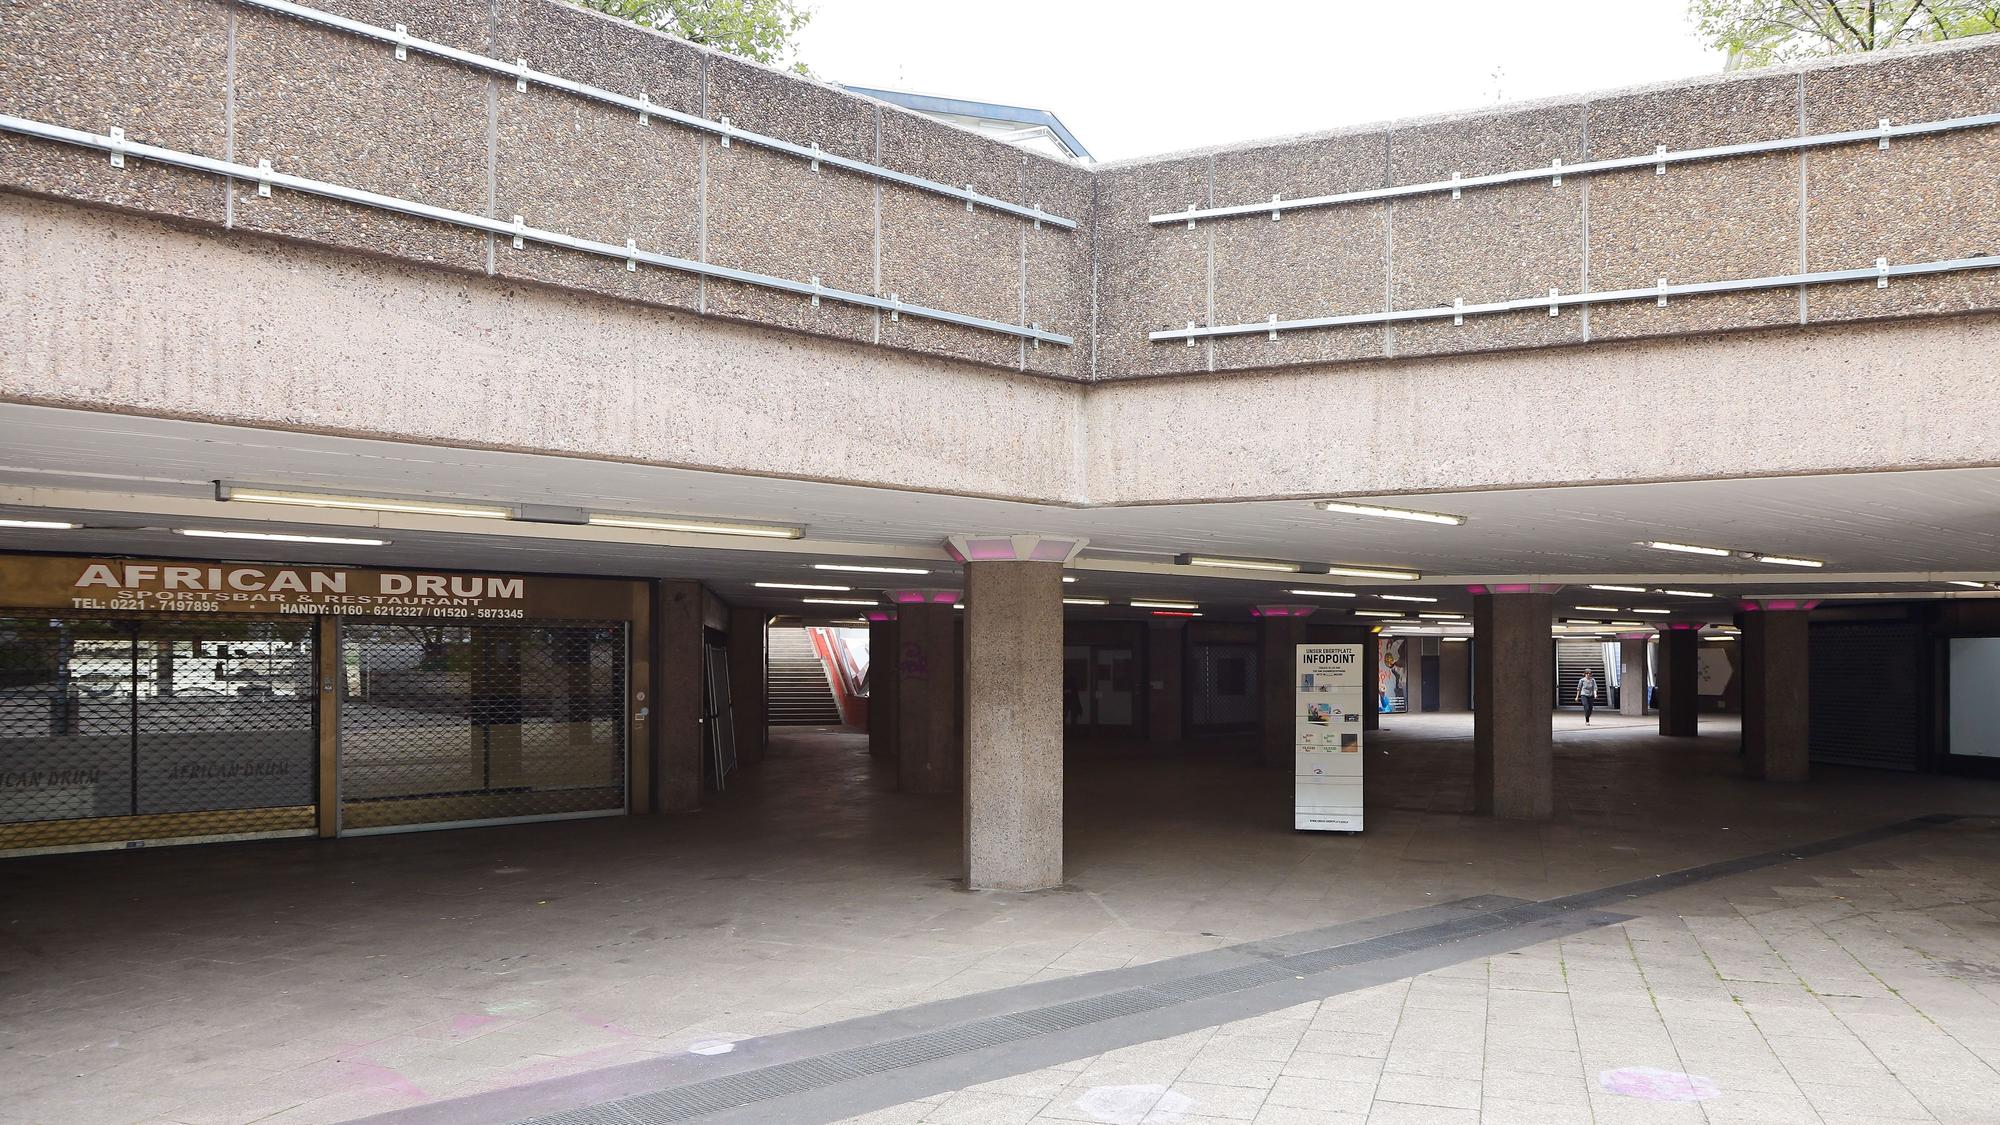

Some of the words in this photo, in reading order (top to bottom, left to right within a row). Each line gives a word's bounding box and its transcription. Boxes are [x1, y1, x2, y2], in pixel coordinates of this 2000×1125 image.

[74, 564, 347, 592] AFRICAN
[380, 573, 524, 599] DRUM
[72, 597, 106, 609] TEL:
[110, 599, 145, 610] 0221
[160, 600, 219, 612] 7197895
[117, 590, 286, 602] SPORTSBAR
[296, 594, 313, 603] &
[324, 595, 483, 606] RESTAURANT
[279, 603, 329, 615] HANDY:
[333, 605, 363, 616] 0160
[373, 606, 423, 617] 6212327
[433, 608, 468, 618] 01520
[477, 609, 524, 619] 5873345
[1303, 654, 1355, 664] INFOPOINT
[242, 761, 290, 776] DRUM
[48, 769, 100, 785] DRUM
